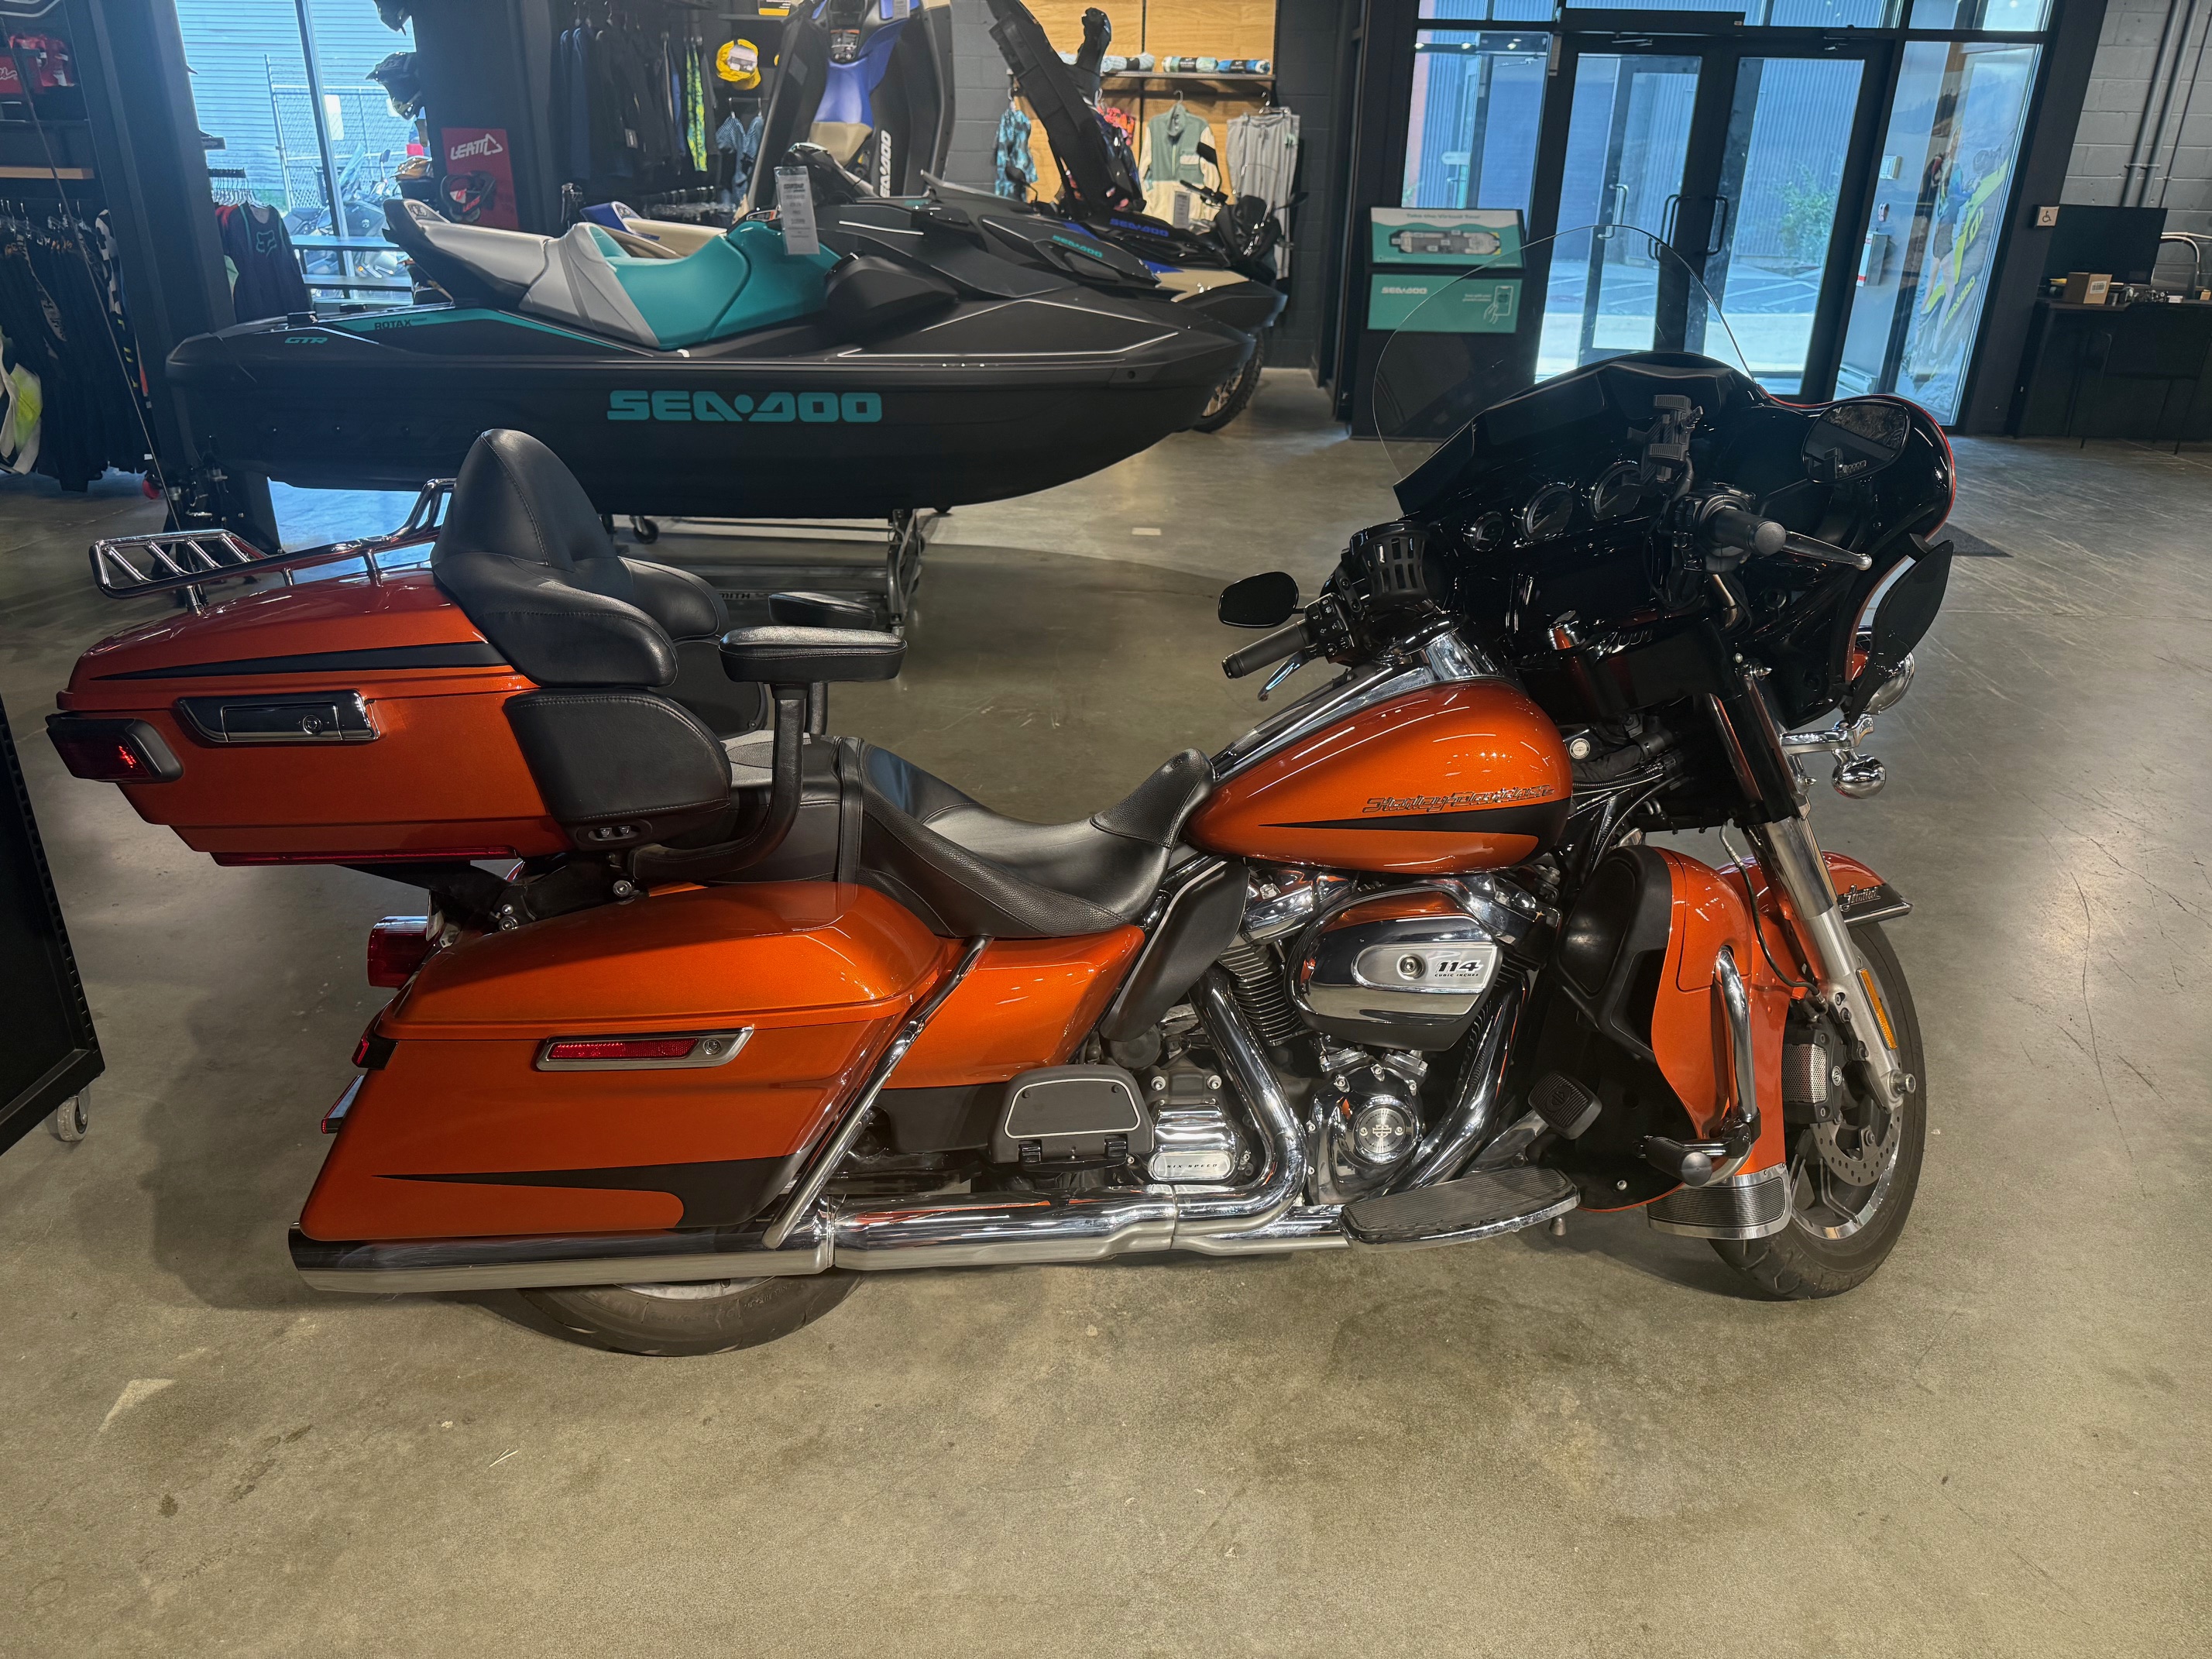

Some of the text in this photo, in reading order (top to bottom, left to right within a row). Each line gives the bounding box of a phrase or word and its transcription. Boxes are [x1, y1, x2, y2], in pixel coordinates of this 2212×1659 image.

[374, 318, 413, 331] ROTAX
[284, 336, 328, 345] GTR
[1437, 960, 1482, 973] 114
